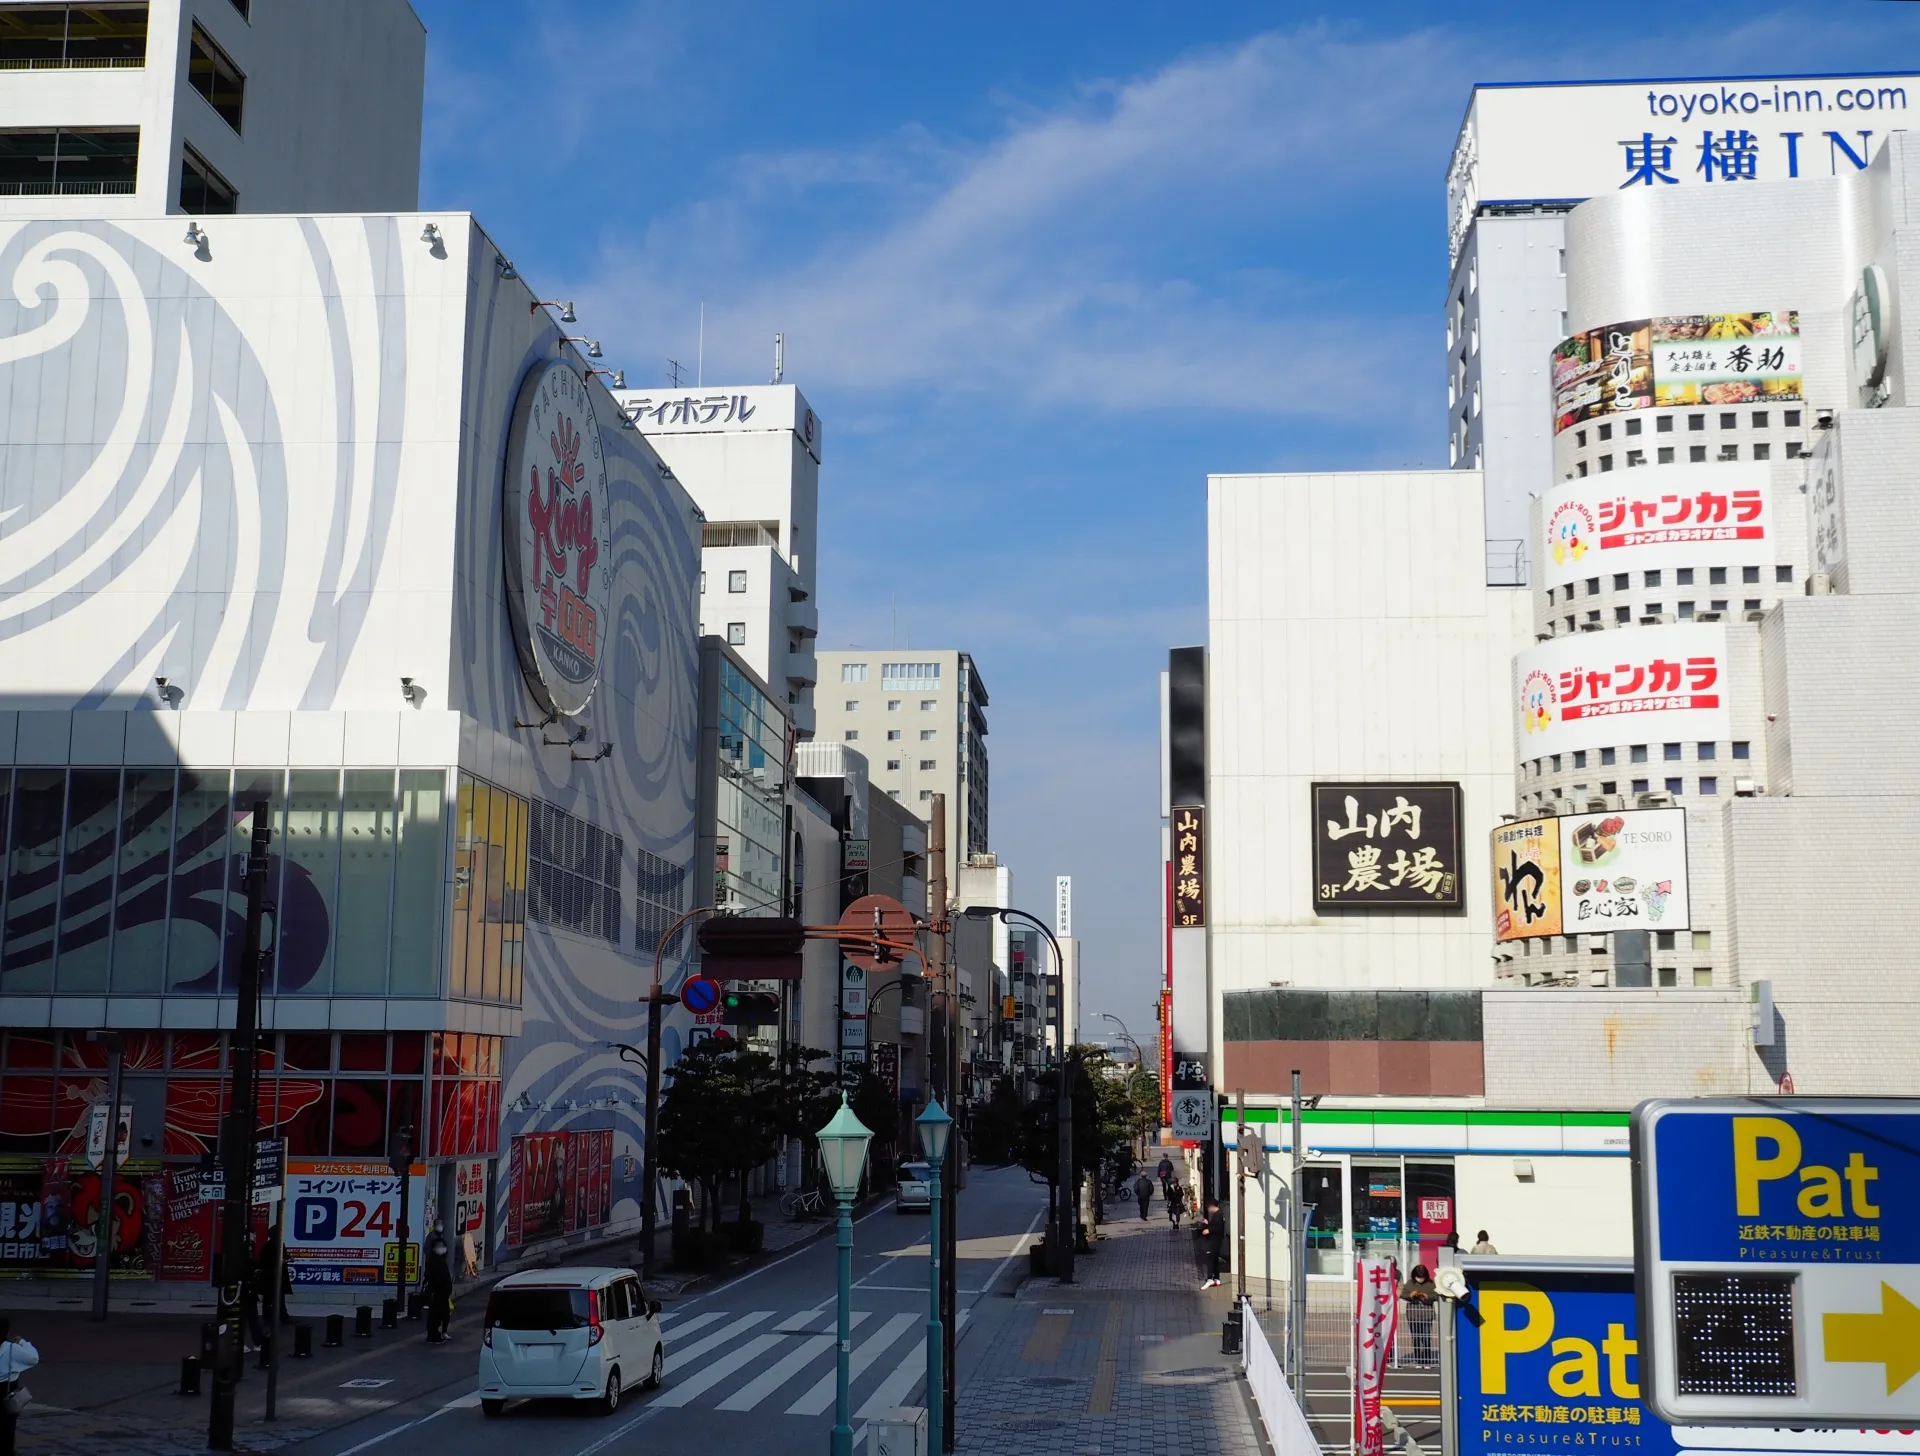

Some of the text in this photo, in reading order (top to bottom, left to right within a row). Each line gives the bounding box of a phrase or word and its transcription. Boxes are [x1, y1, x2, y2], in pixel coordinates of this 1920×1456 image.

[1647, 84, 1907, 122] toyoko-inn.com
[1724, 343, 1785, 373] 番助
[621, 395, 757, 425] ティホテル
[1599, 489, 1763, 533] ジャンカラ
[528, 464, 599, 599] King
[552, 644, 581, 677] KANKO
[1560, 657, 1719, 703] ジャンカラ
[1327, 795, 1423, 841] 山内
[1177, 810, 1201, 901] 山内農場
[1342, 844, 1444, 894] 農場
[1321, 884, 1340, 899] 3F
[1499, 849, 1547, 925] わん
[1182, 915, 1198, 926] 3F
[1578, 896, 1639, 921] 居心家
[1180, 1098, 1202, 1127] 番助
[1733, 1117, 1881, 1219] Pat
[174, 1180, 197, 1194] 1120
[169, 1209, 193, 1222] 1003
[305, 1200, 409, 1239] P 24
[457, 1199, 477, 1232] P 入口
[1425, 1211, 1446, 1219] ATM
[1426, 1201, 1445, 1211] 銀行
[1738, 1224, 1881, 1243] 近鉄不動産の駐車場
[297, 1272, 341, 1282] キング観光
[1478, 1281, 1640, 1399] Pat
[1482, 1403, 1641, 1427] 近鉄不動産の駐車場
